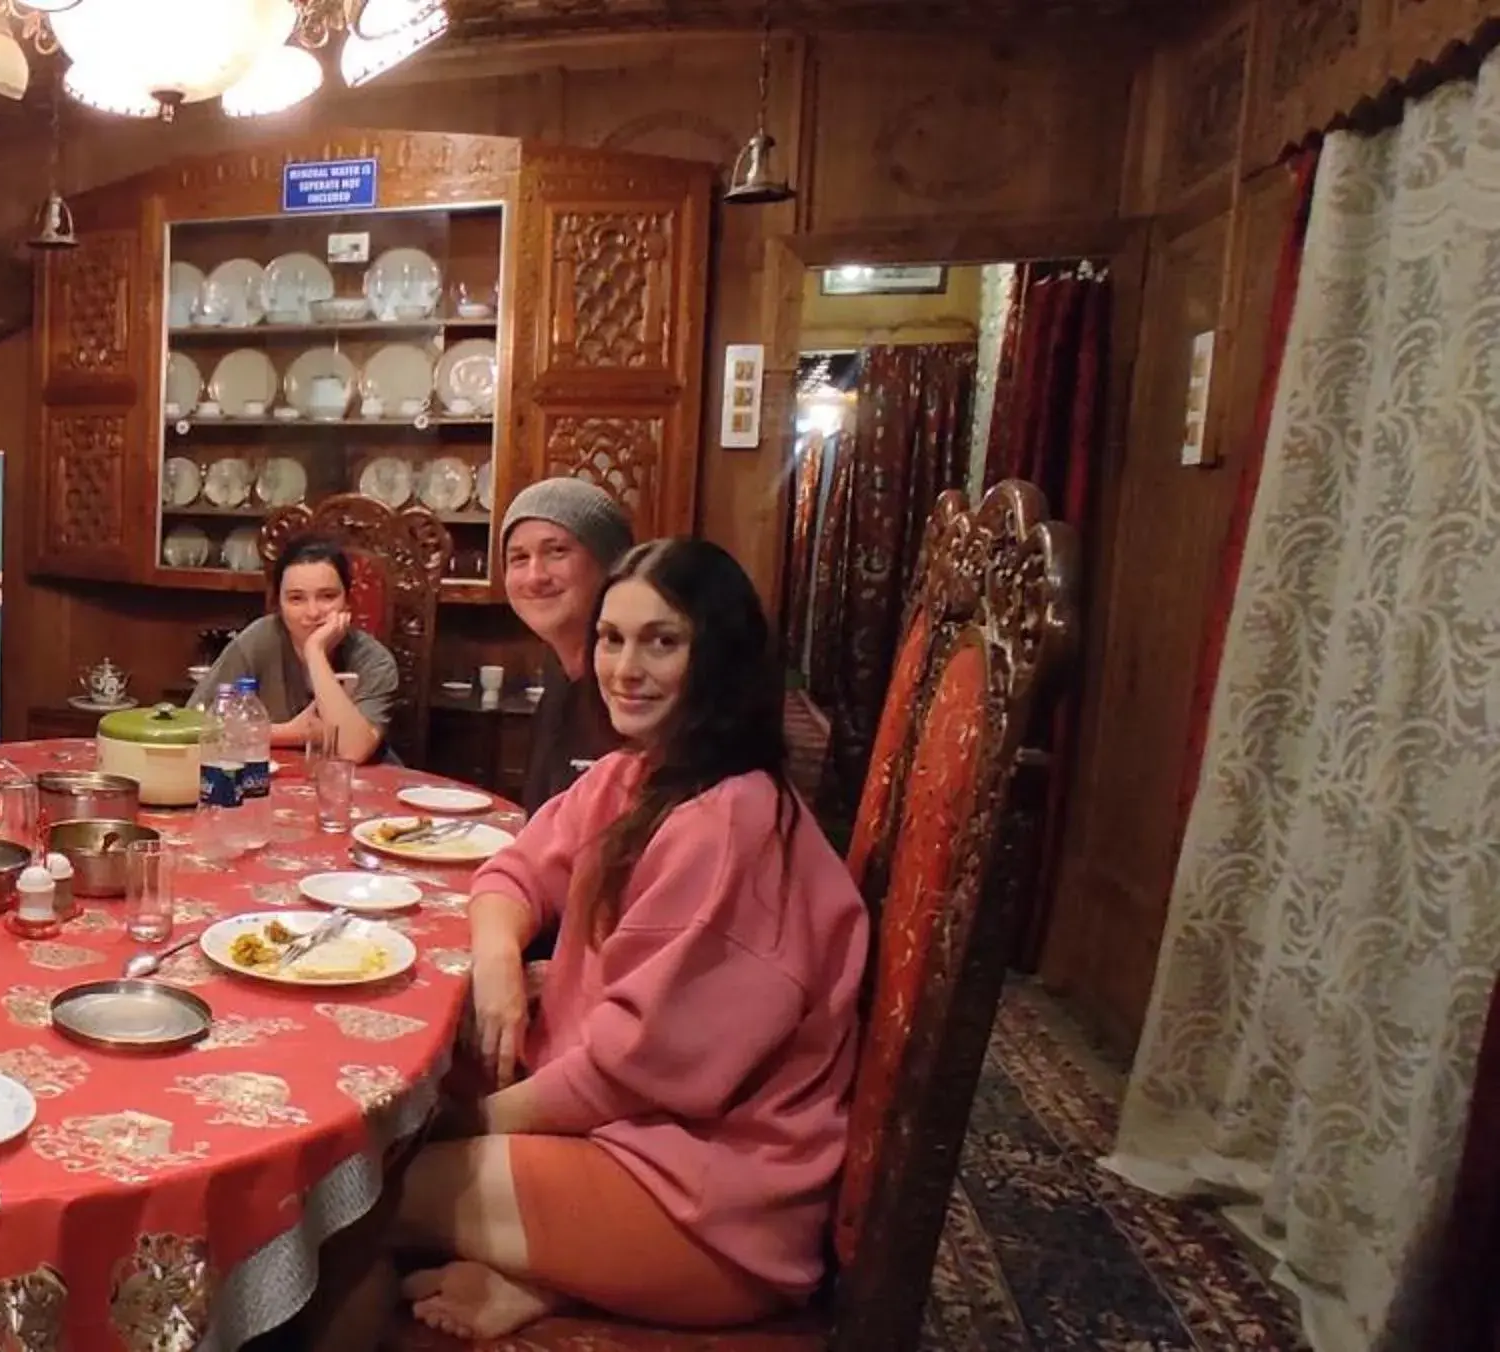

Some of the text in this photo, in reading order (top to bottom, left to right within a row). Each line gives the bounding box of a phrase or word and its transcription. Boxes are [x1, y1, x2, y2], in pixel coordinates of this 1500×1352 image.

[289, 164, 371, 180] MINERAL WATER IS
[341, 178, 361, 189] NOT
[308, 191, 351, 203] INCLUDED
